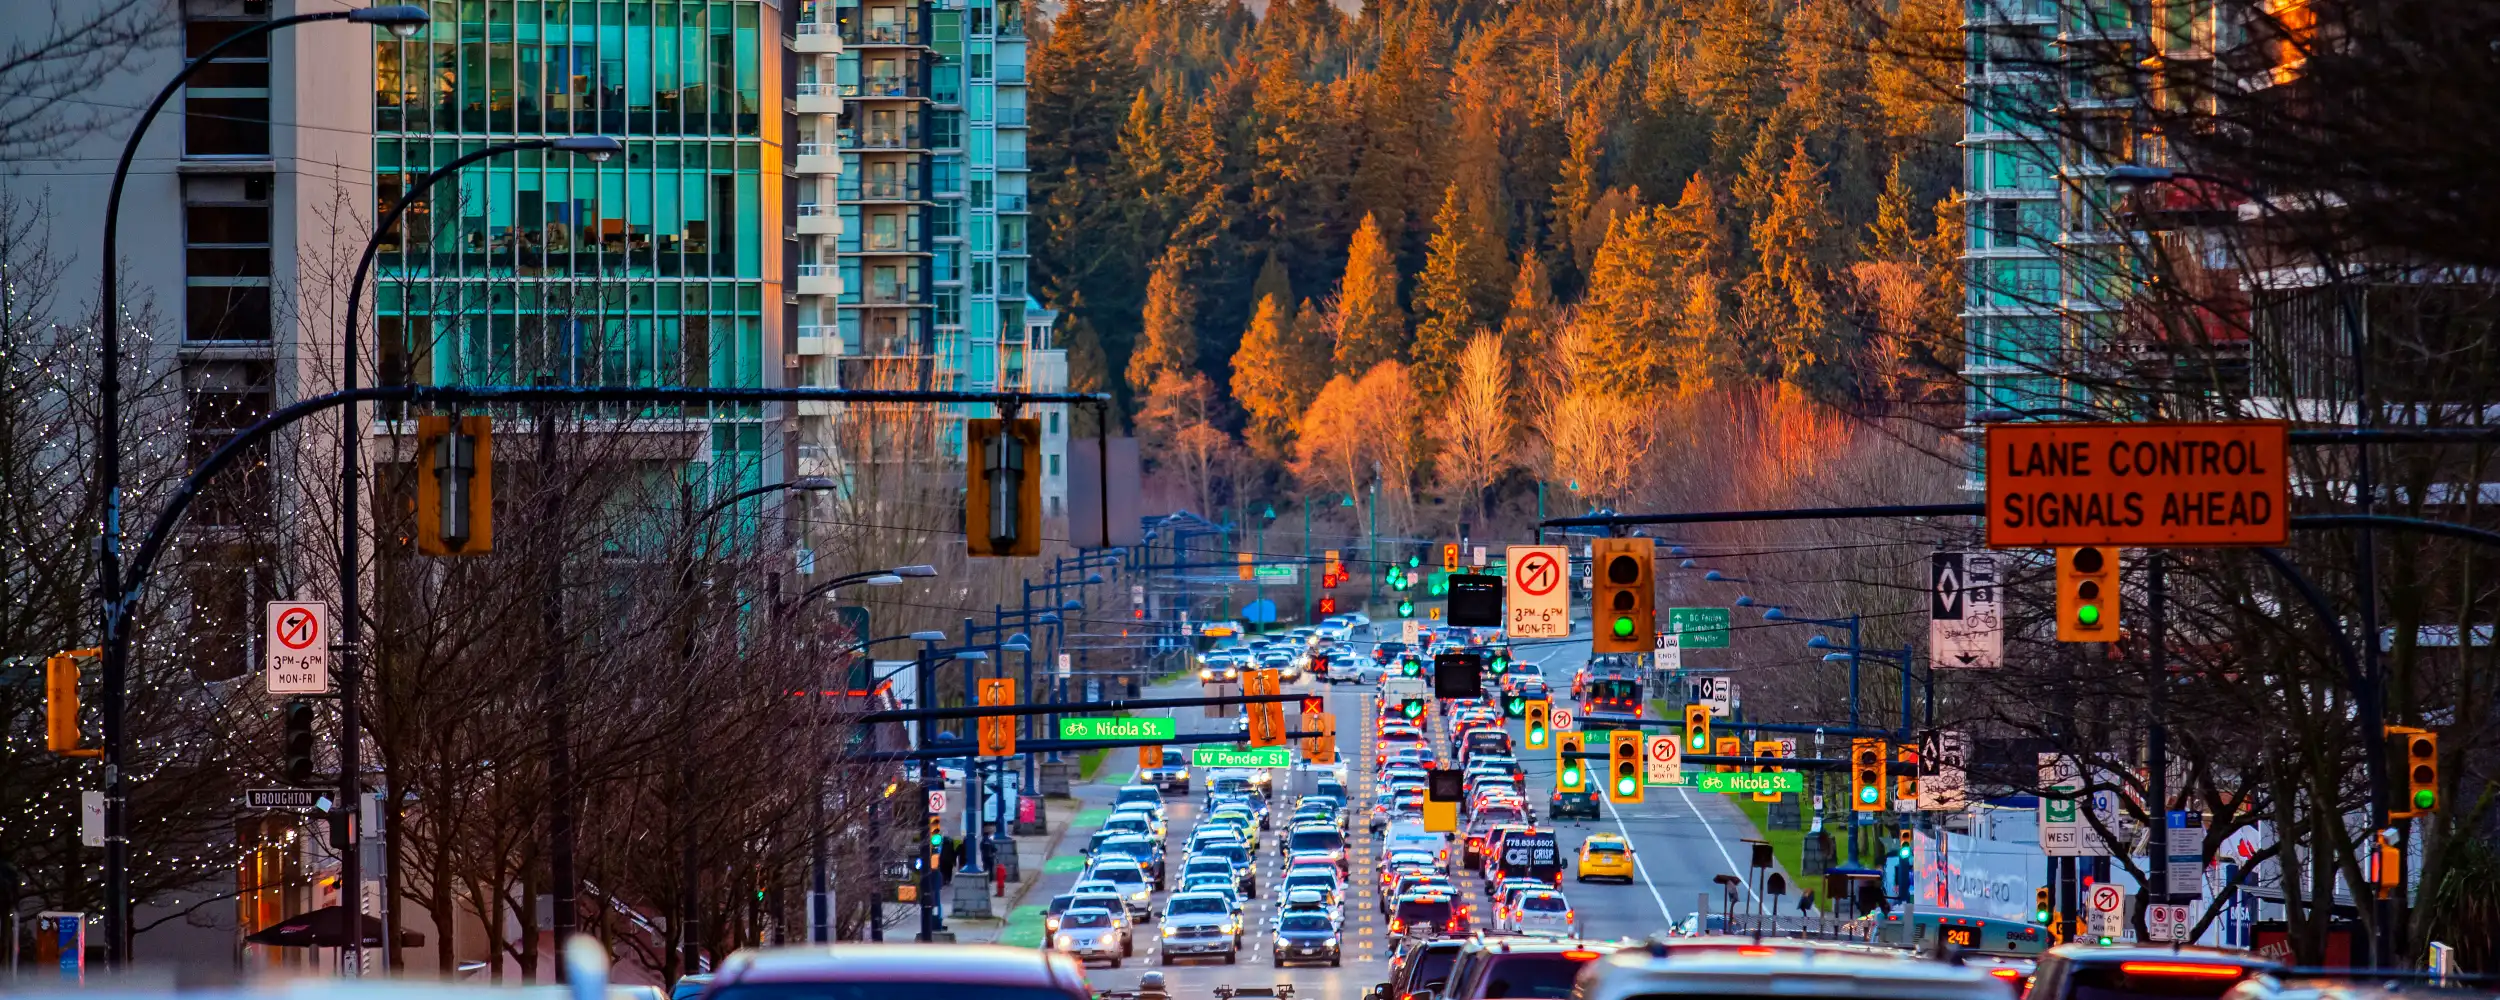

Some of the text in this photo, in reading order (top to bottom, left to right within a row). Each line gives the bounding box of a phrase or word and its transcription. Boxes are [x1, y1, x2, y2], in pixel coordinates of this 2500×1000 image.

[2008, 440, 2265, 476] LANE CONTROL
[2004, 491, 2272, 527] SIGNALS AHEAD
[1517, 623, 1556, 634] MON-FRI
[273, 656, 322, 670] 3PM-6PM
[278, 673, 316, 684] MON-FRI
[1096, 721, 1162, 736] Nicola St.
[1200, 753, 1283, 765] W Pender St
[1730, 775, 1791, 789] Nicola St.
[255, 792, 312, 805] BROUGHTON
[2048, 832, 2075, 843] WEST
[1533, 848, 1554, 860] CRISP
[1947, 929, 1970, 945] 241
